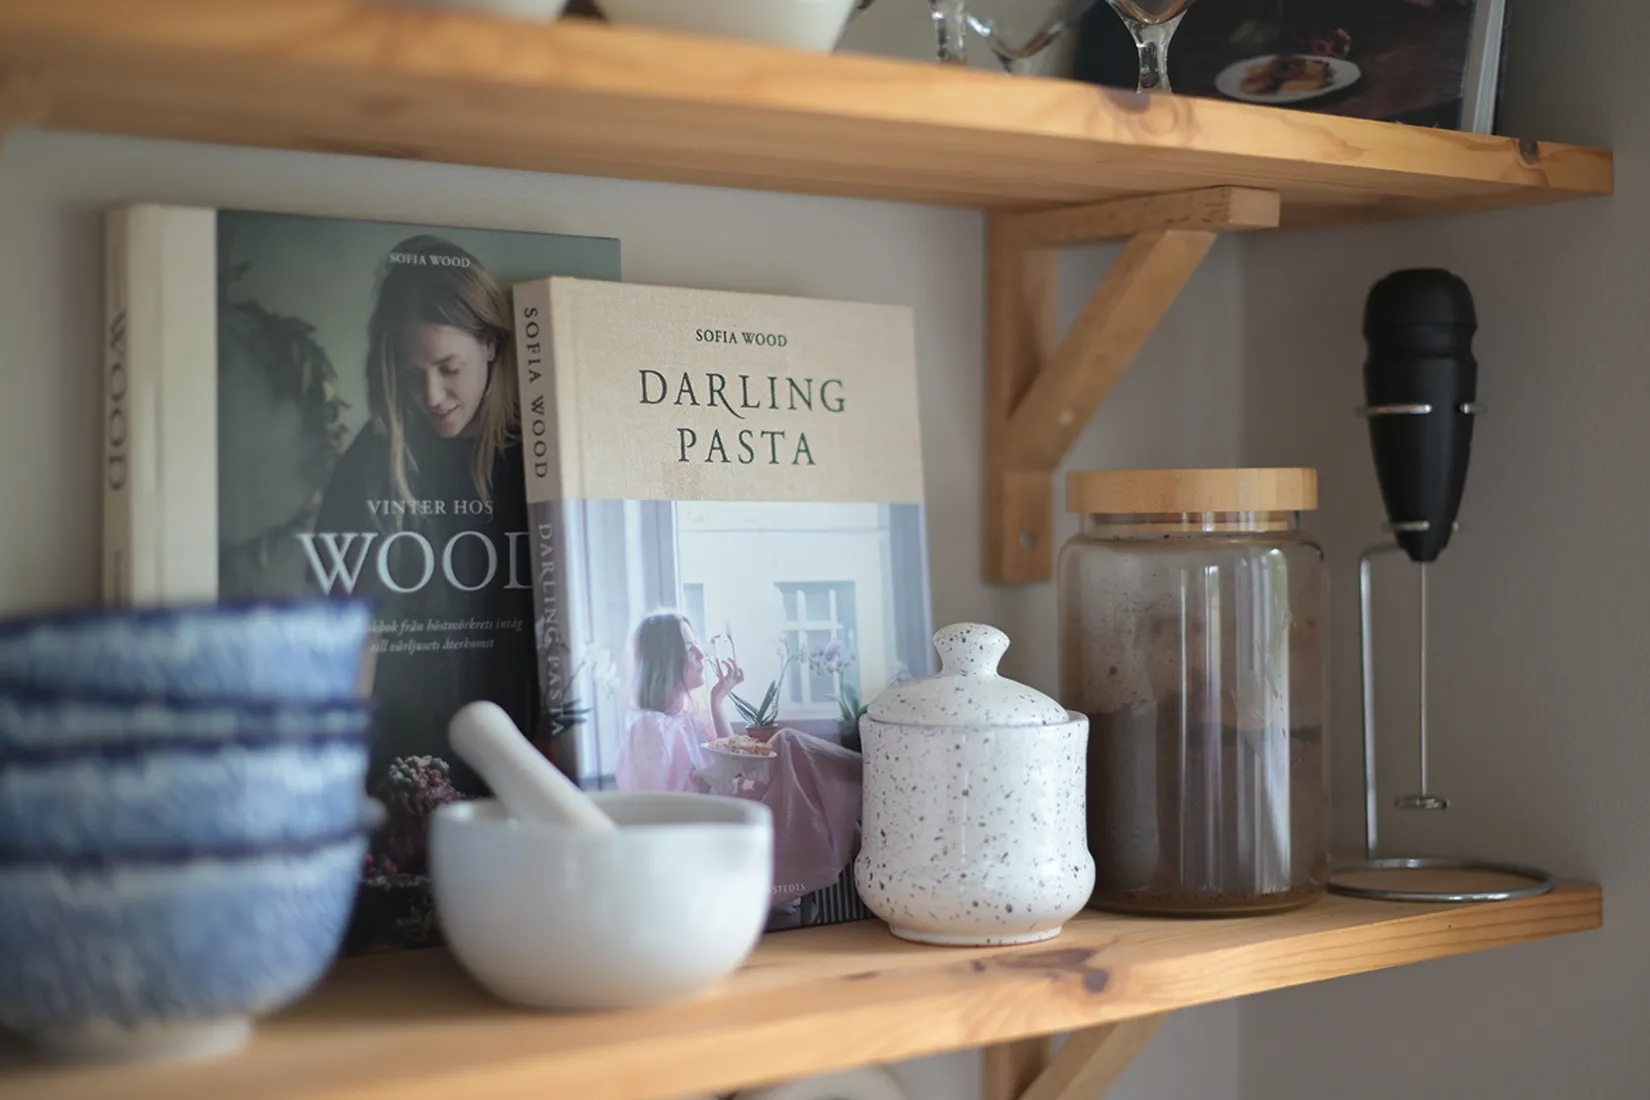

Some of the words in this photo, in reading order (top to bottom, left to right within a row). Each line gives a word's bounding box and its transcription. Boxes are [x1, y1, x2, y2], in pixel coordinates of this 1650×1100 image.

[389, 252, 427, 266] SOFIA
[429, 255, 471, 268] WOOD
[524, 306, 542, 384] SOFIA
[695, 328, 738, 344] SOFIA
[742, 332, 788, 347] WOOD
[108, 308, 128, 492] WOOD
[638, 369, 846, 420] DARLING
[531, 395, 548, 478] WOOD
[676, 427, 816, 466] PASTA
[366, 500, 447, 515] VINTER
[454, 500, 494, 515] HOS
[538, 523, 560, 649] DARLING
[547, 655, 565, 735] PASTA
[771, 882, 806, 894] STEDTS
